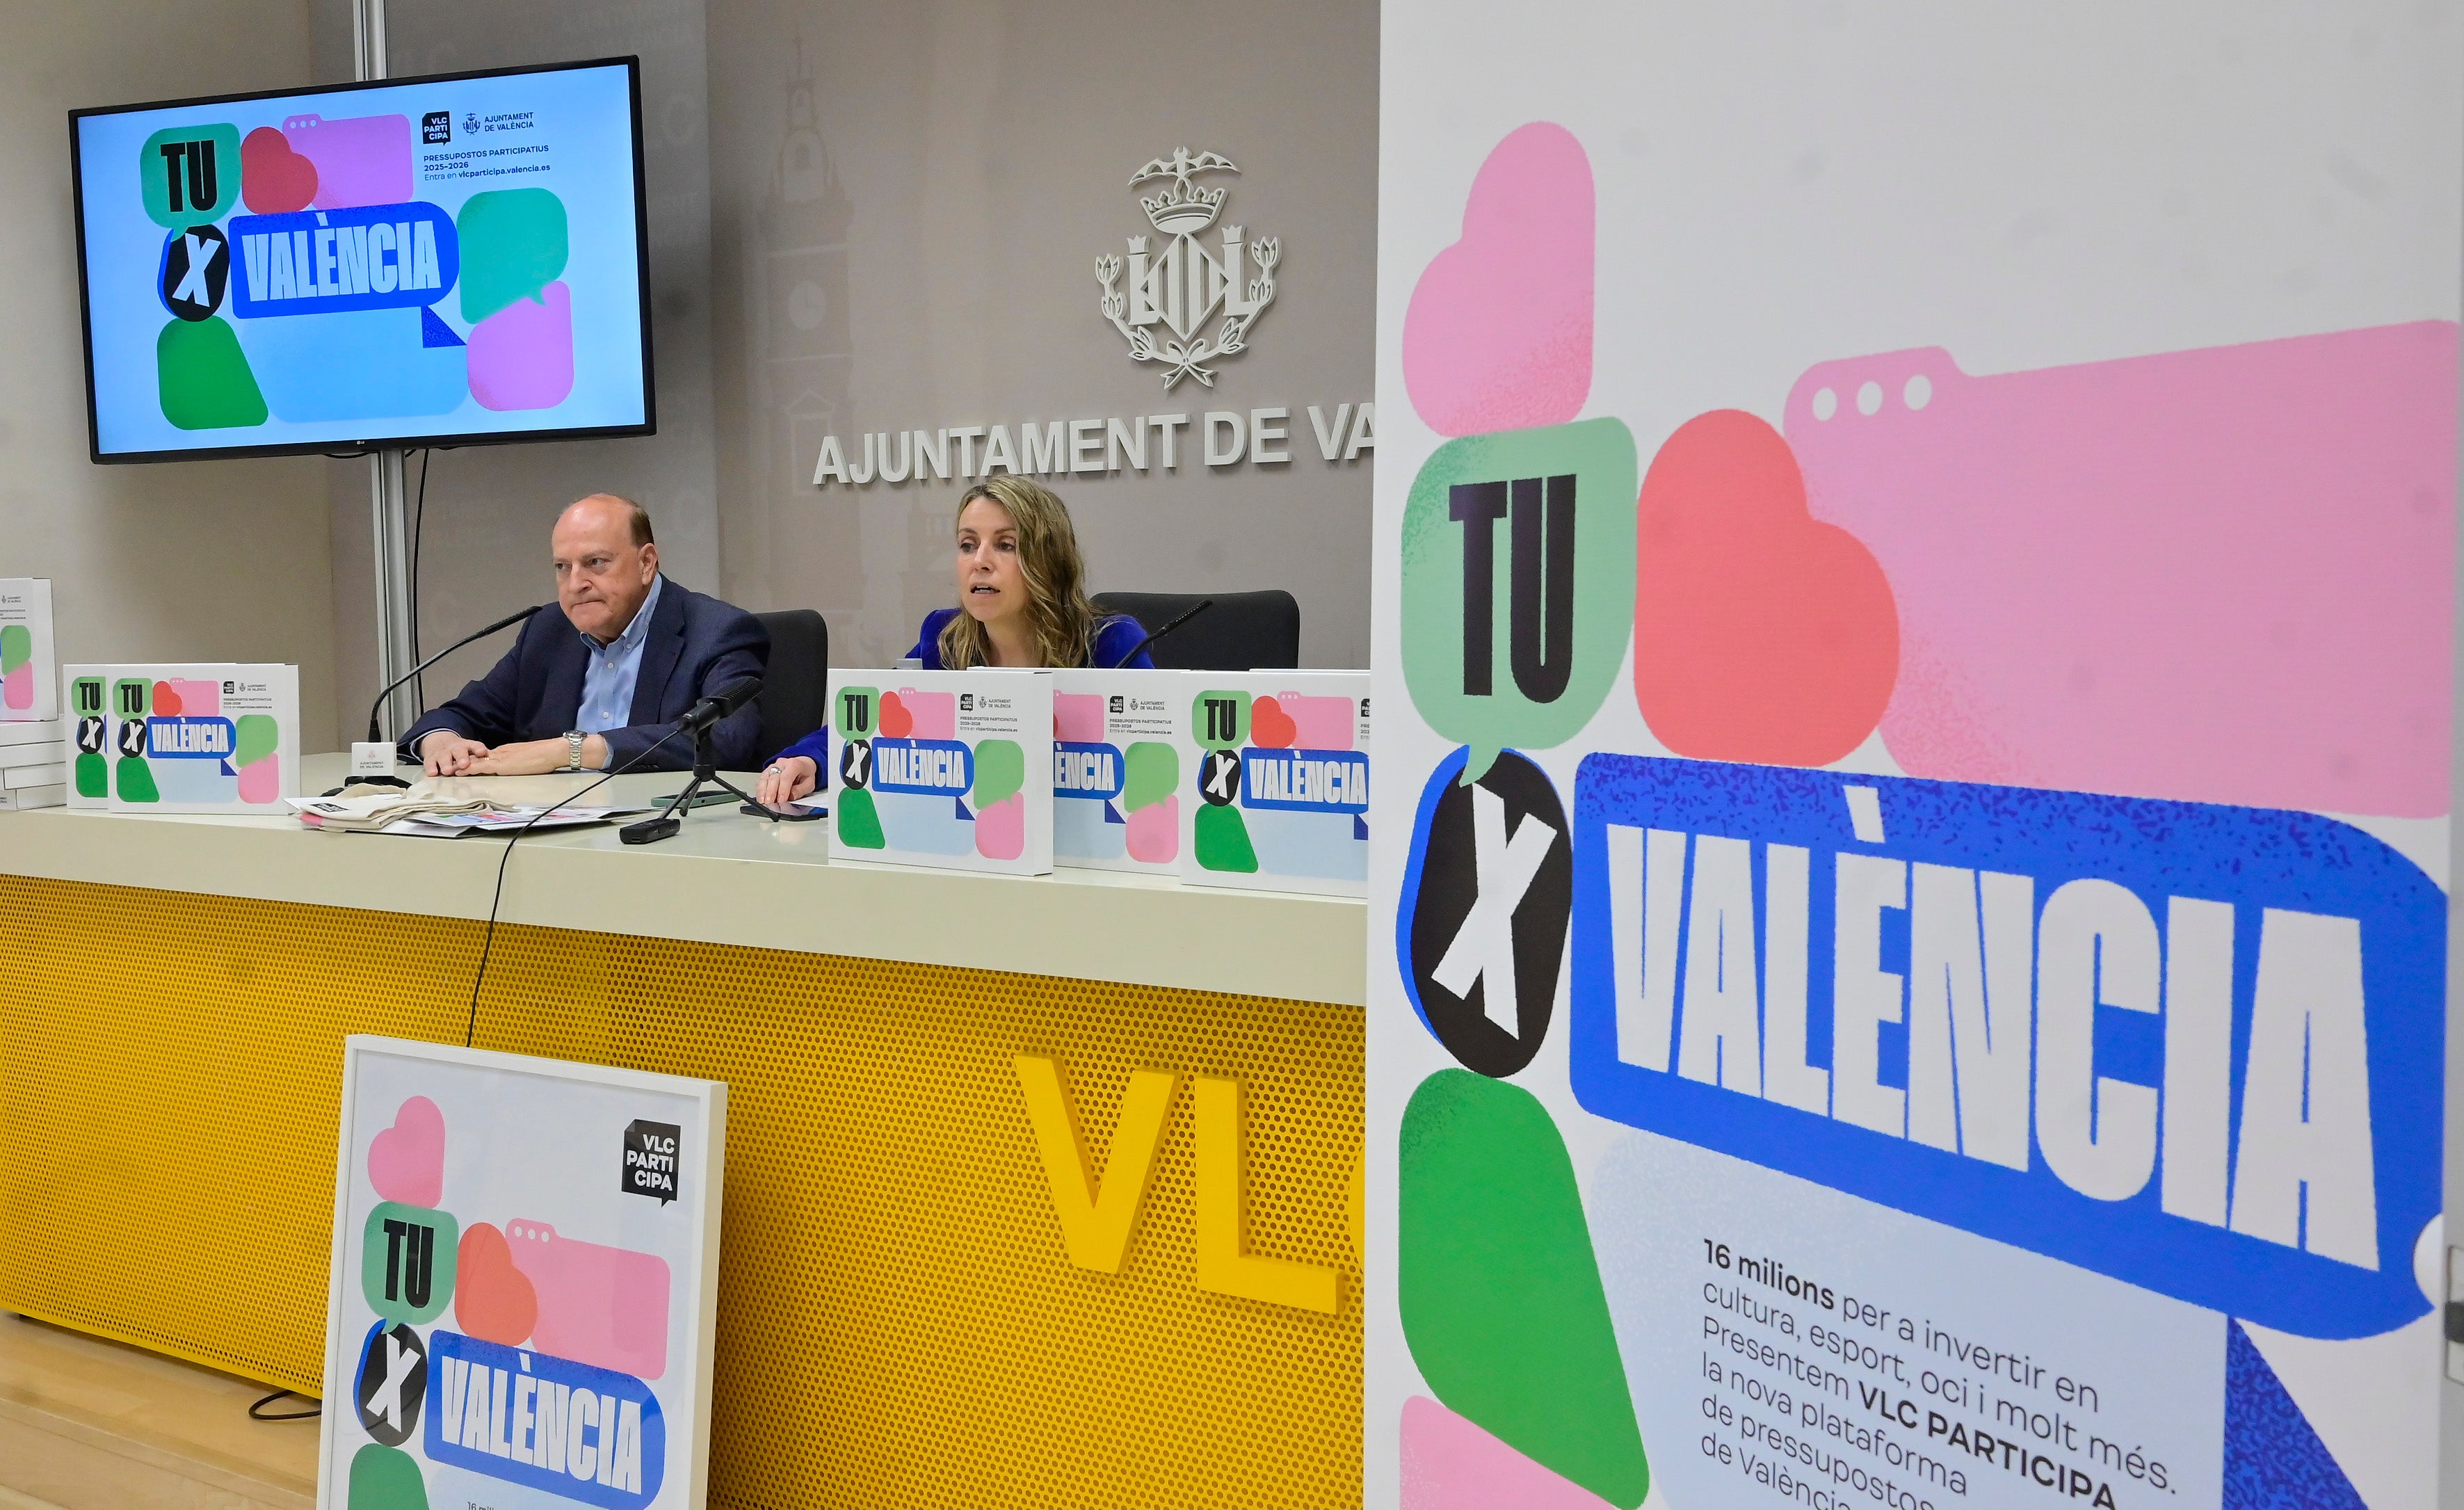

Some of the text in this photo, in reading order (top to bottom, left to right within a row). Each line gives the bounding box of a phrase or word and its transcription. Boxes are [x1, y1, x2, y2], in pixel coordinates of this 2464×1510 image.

[424, 125, 447, 134] PARTI
[485, 112, 533, 123] AJUNTAMENT
[497, 121, 534, 131] VALÈNCIA
[424, 145, 549, 162] PRESSUPOSTOS PARTICIPATIUS
[424, 172, 445, 181] Entra
[458, 165, 550, 178] vlcparticipa.valencia.es
[160, 139, 216, 212] TU
[172, 211, 441, 307] X VALÈNCIA
[813, 412, 1189, 485] AJUNTAMENT
[1205, 407, 1292, 467] DE
[1448, 473, 1577, 704] TU
[79, 682, 100, 711] TU
[121, 684, 143, 713] TU
[844, 694, 869, 732] TU
[82, 717, 102, 749] X
[123, 717, 229, 753] X VALÈNCIA
[1205, 699, 1237, 741] TU
[845, 739, 965, 788] X VALÈNCIA
[1053, 742, 1116, 792] ÈNCIA
[1205, 750, 1367, 805] X VALÈNCIA
[1431, 781, 2381, 1273] X VALÈNCIA
[627, 1150, 674, 1173] PARTI
[643, 1134, 675, 1154] VLC
[634, 1170, 673, 1191] CIPA
[383, 1218, 435, 1309] TU
[1704, 1239, 2098, 1413] 16 milions per a invertir en
[1704, 1283, 2176, 1495] cultura, esport, oci i molt més.
[366, 1333, 642, 1495] X VALÈNCIA
[1702, 1394, 1733, 1426] de
[1703, 1351, 1967, 1496] la nova plataforma
[1705, 1316, 2117, 1510] Presentem VLC PARTICIPA
[1702, 1432, 1732, 1465] de
